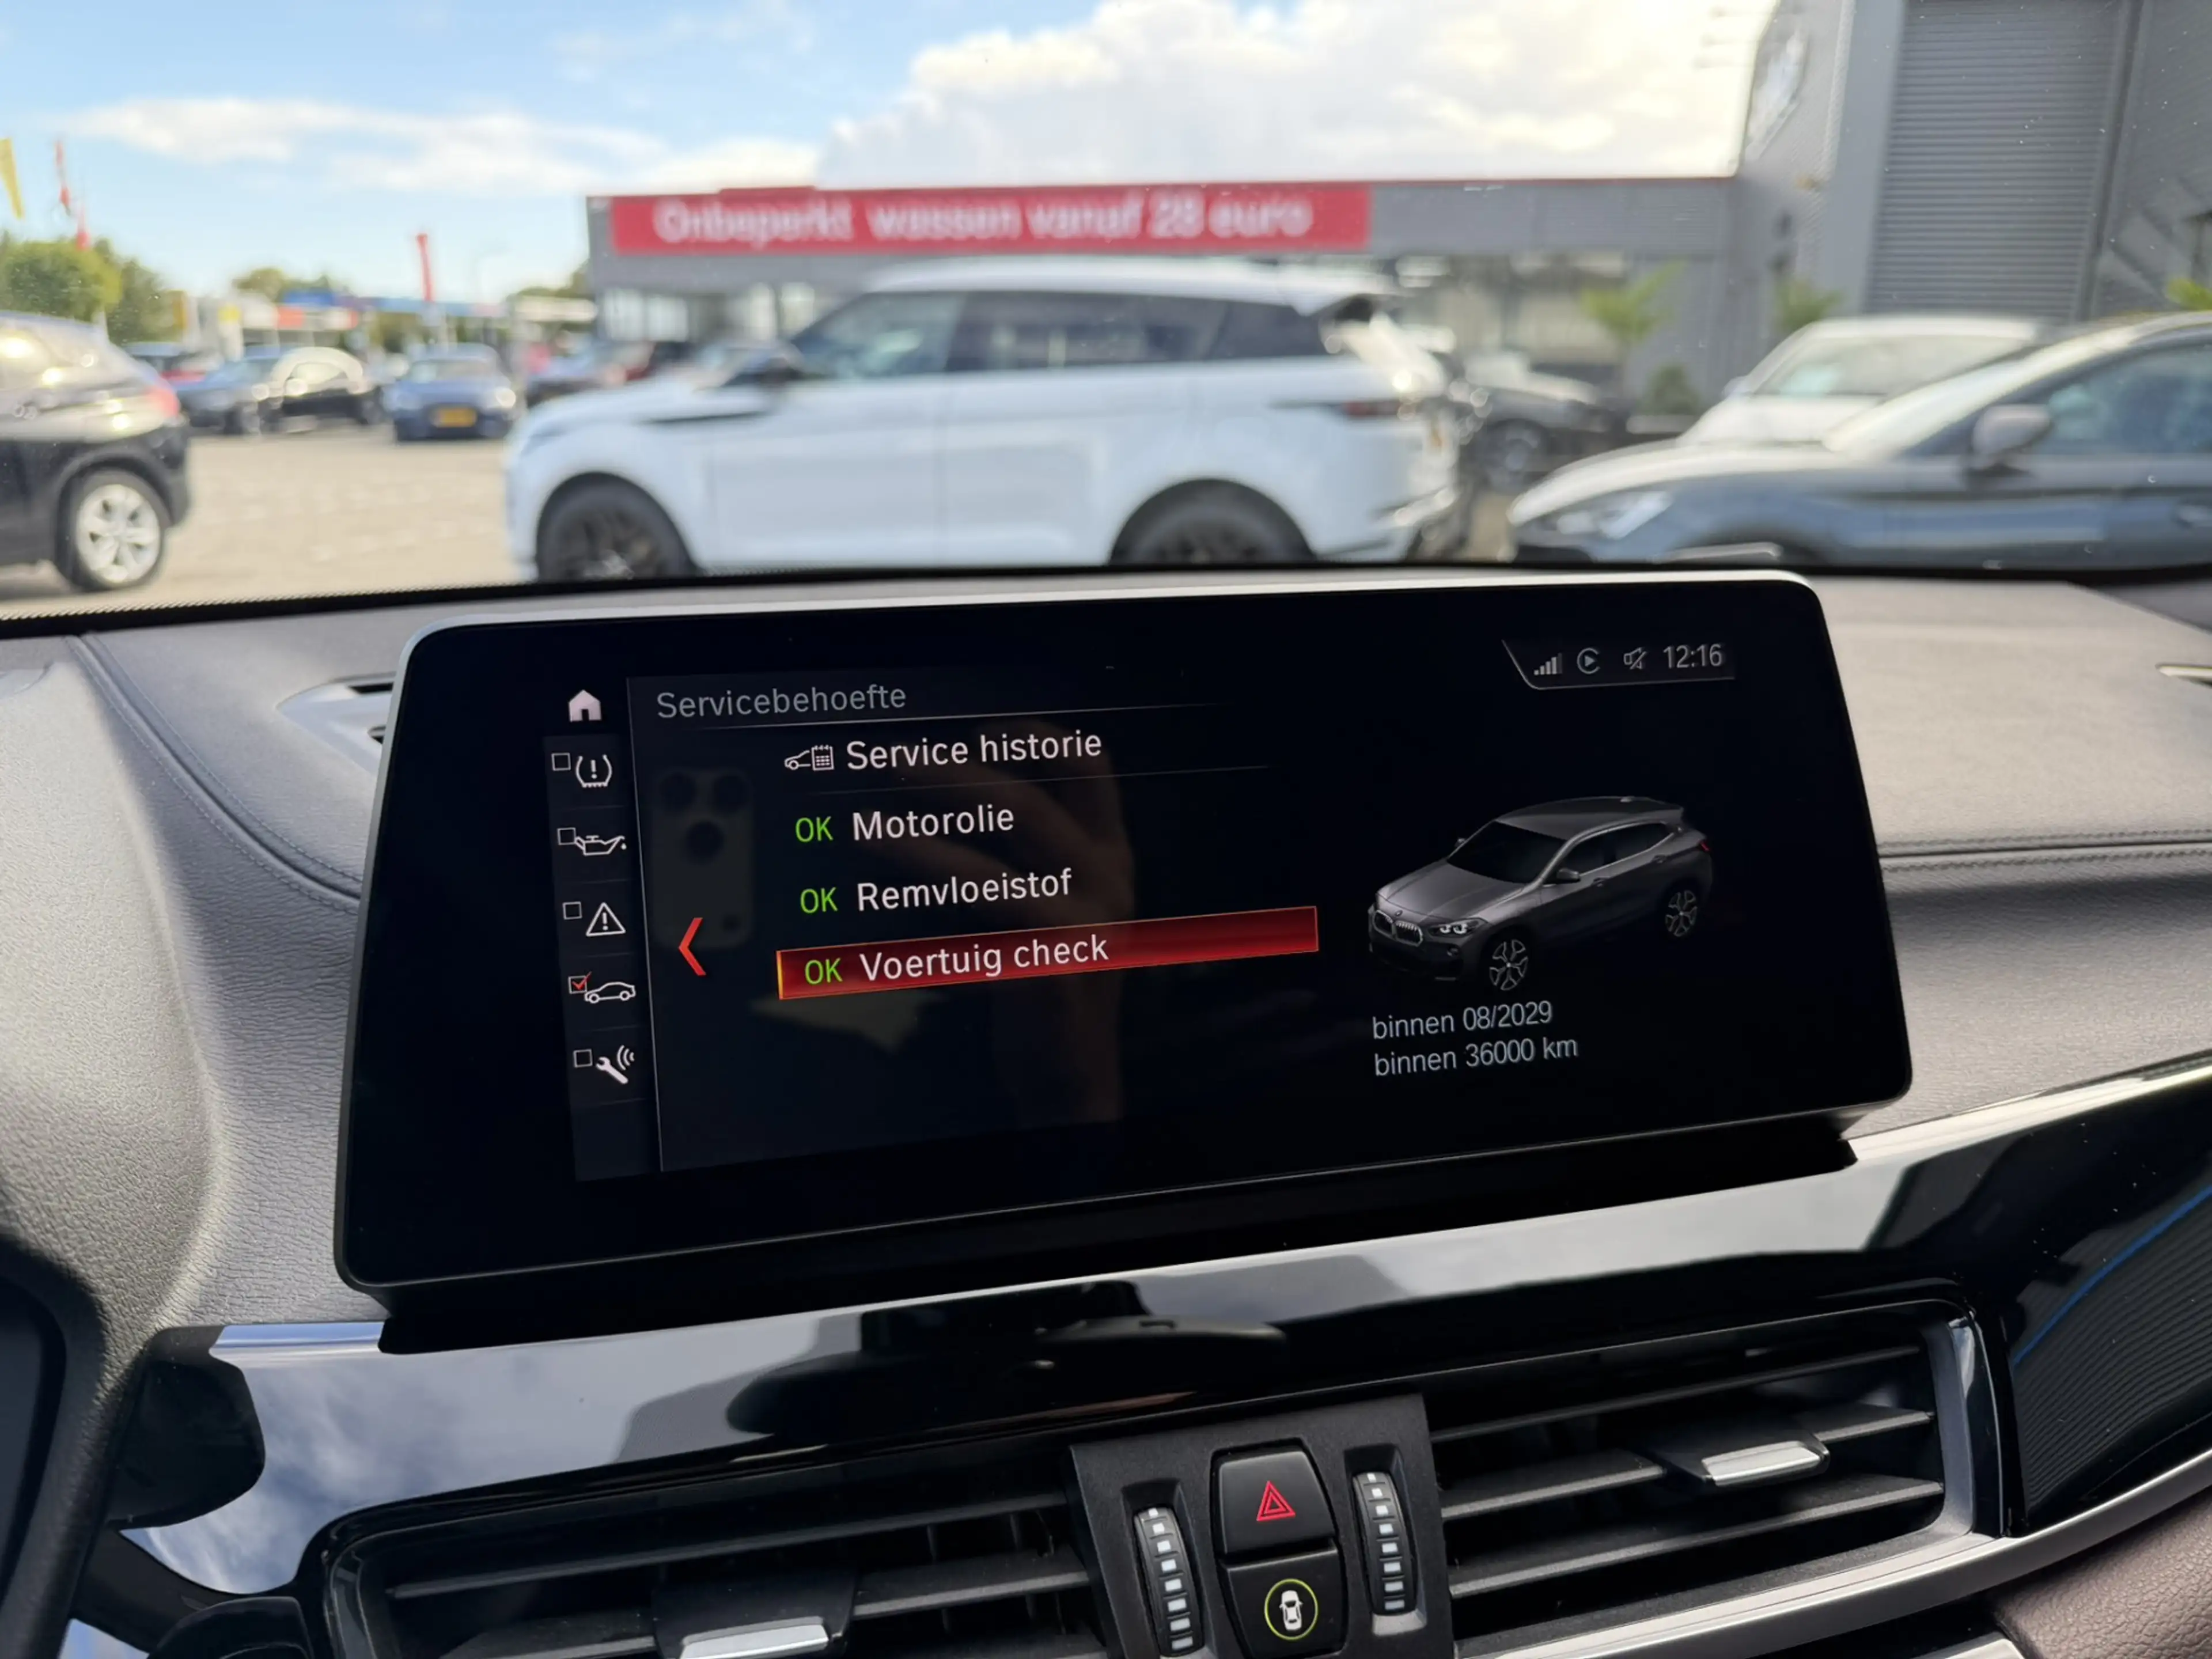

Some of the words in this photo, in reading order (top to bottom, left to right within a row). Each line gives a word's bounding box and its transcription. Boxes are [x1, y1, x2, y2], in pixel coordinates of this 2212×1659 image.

[866, 199, 1022, 240] wassen
[1027, 192, 1144, 240] vanaf
[1209, 199, 1313, 238] euro
[1663, 643, 1723, 669] 12:16
[656, 684, 907, 719] Servicebehoefte
[847, 737, 969, 770] Service
[980, 729, 1102, 763] historie
[796, 816, 834, 843] OK
[853, 804, 1014, 841] Motorolie
[800, 887, 838, 914] OK
[857, 867, 1073, 911] Remvloeistof
[805, 958, 843, 985] OK
[859, 944, 1003, 982] Voertuig
[1013, 934, 1109, 968] check
[1372, 1014, 1455, 1040] binnen
[1462, 1000, 1553, 1031] 08/2029
[1374, 1050, 1457, 1077] binnen
[1465, 1037, 1535, 1067] 36000
[1542, 1036, 1578, 1060] km
